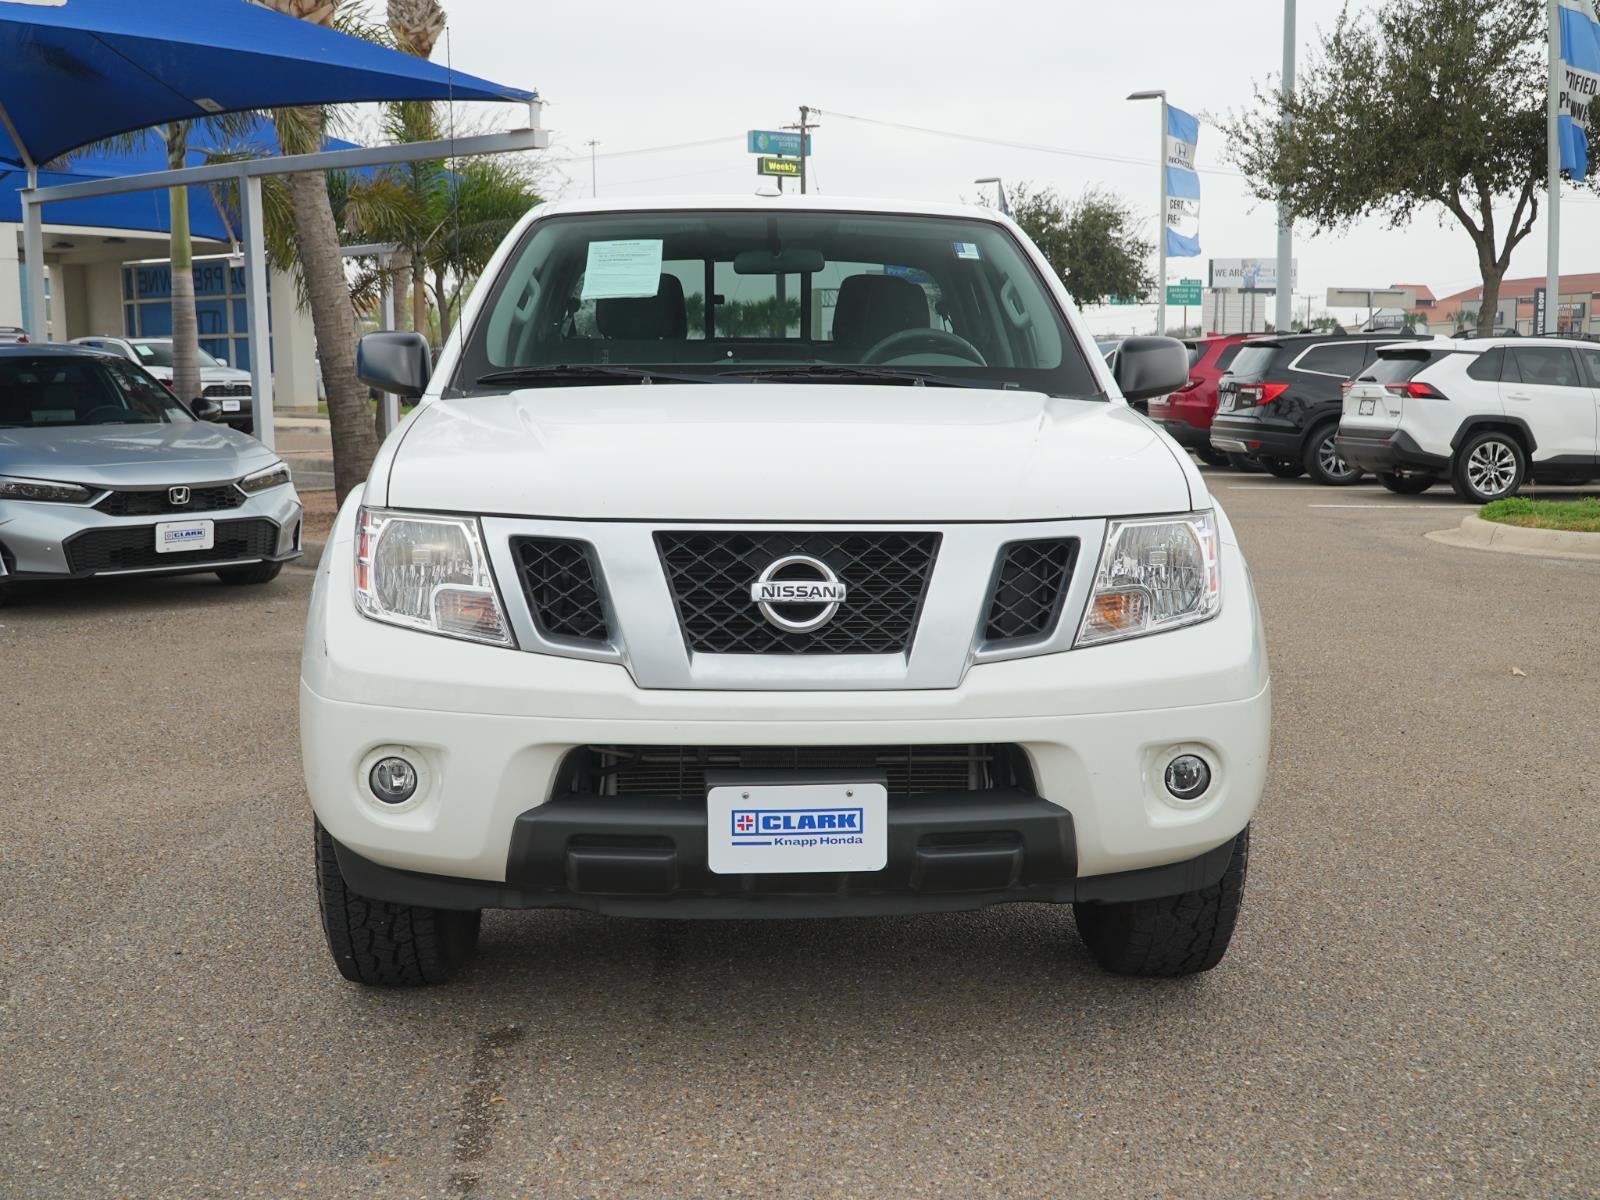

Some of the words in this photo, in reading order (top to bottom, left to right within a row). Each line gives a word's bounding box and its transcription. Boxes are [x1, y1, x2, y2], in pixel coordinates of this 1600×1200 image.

[768, 162, 797, 172] Weekly
[1215, 268, 1227, 278] WE
[1228, 268, 1244, 278] ARE
[174, 530, 203, 538] CLARK
[761, 585, 837, 598] NISSAN
[762, 813, 857, 831] CLARK
[774, 836, 817, 847] Knapp
[819, 835, 864, 846] Honda
